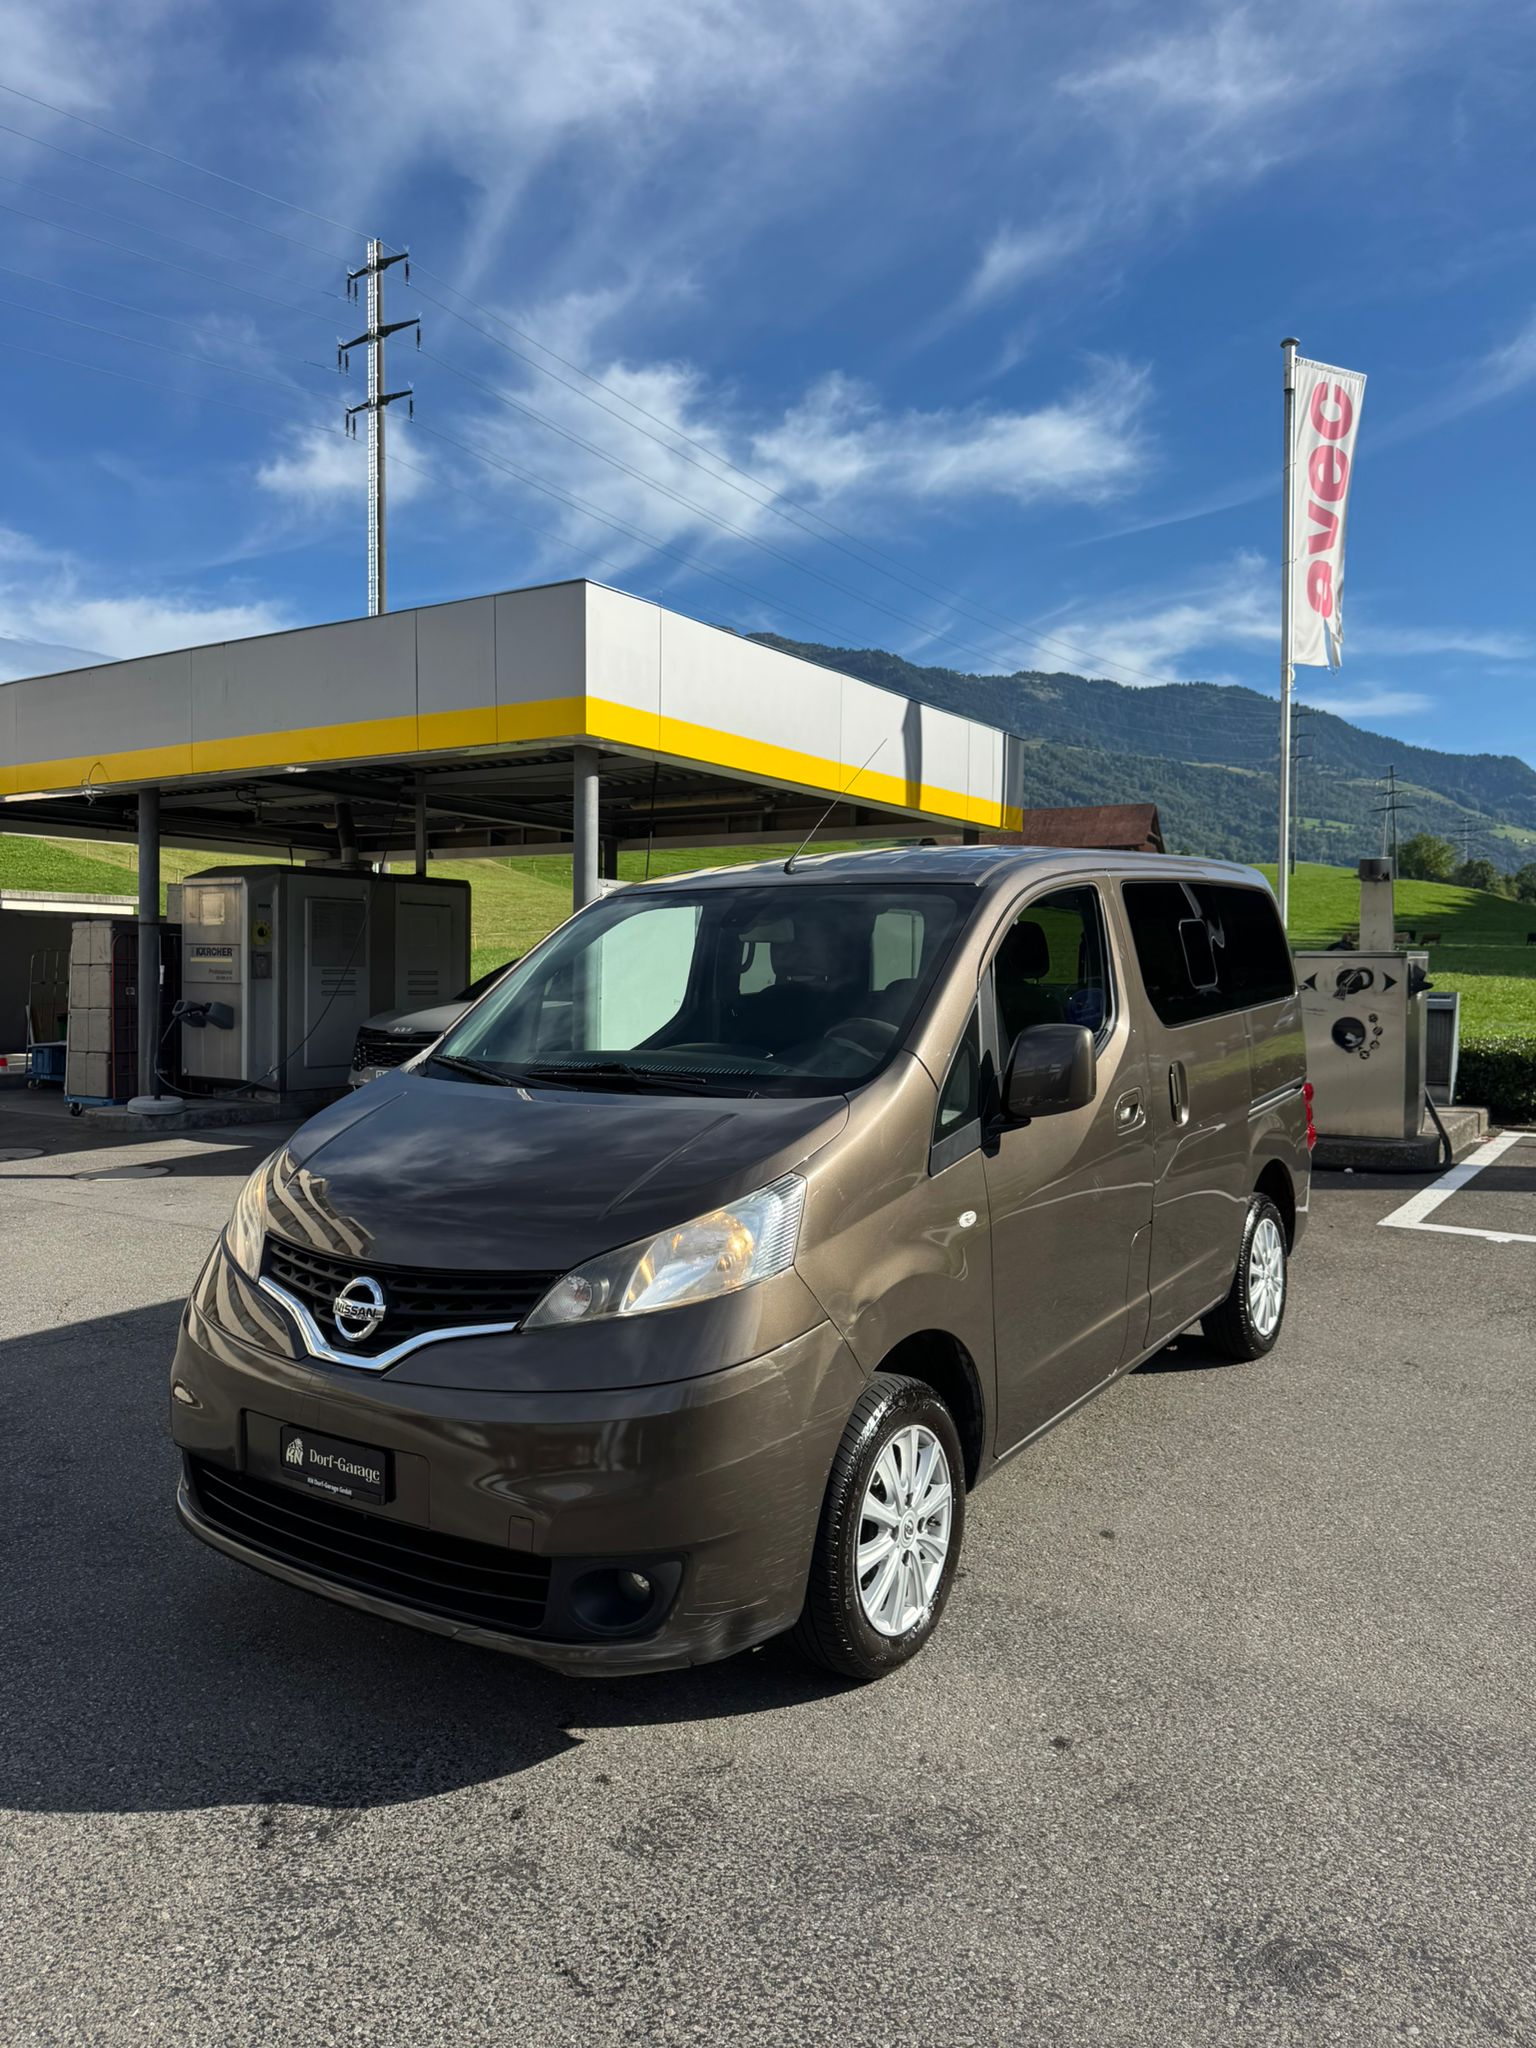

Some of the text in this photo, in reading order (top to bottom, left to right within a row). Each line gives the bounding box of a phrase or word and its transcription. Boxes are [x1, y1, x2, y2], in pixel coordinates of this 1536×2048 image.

[1306, 381, 1353, 619] avec
[334, 1300, 377, 1318] NISSAN
[309, 1448, 380, 1484] Dorf-Garage
